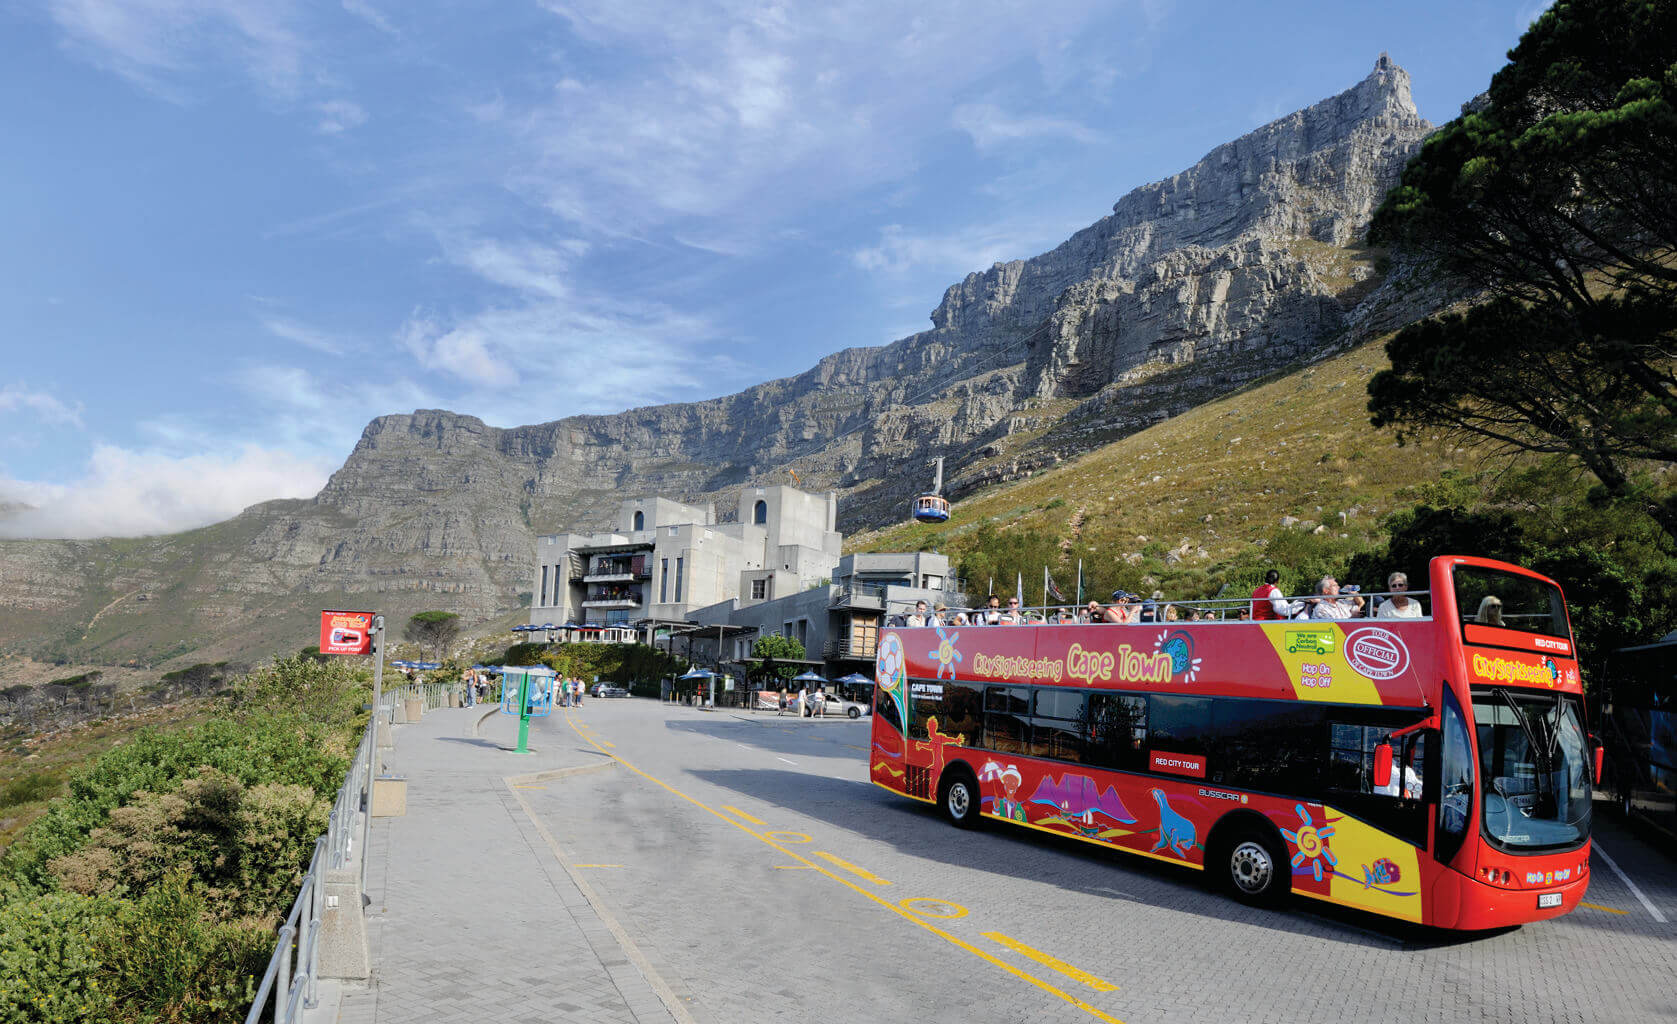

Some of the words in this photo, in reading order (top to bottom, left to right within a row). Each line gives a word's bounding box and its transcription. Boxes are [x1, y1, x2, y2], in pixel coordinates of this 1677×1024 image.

[1372, 630, 1389, 640] TOUR
[1545, 640, 1557, 649] CITY
[1357, 643, 1396, 661] OFFICIAL
[973, 653, 1063, 682] CitySightseeing
[1067, 643, 1115, 684] Cape
[1119, 644, 1173, 683] Town
[1302, 663, 1319, 675] Hop
[1319, 662, 1331, 675] On
[1473, 653, 1554, 688] CitySightseeing
[1301, 676, 1318, 688] Hop
[1318, 676, 1332, 688] Off
[1155, 757, 1168, 766] RED
[1168, 759, 1182, 767] CITY
[1182, 761, 1200, 770] TOUR
[1198, 788, 1240, 801] BUSSCAR
[1526, 872, 1537, 884] Hop
[1537, 871, 1544, 883] On
[1554, 870, 1564, 881] Hop
